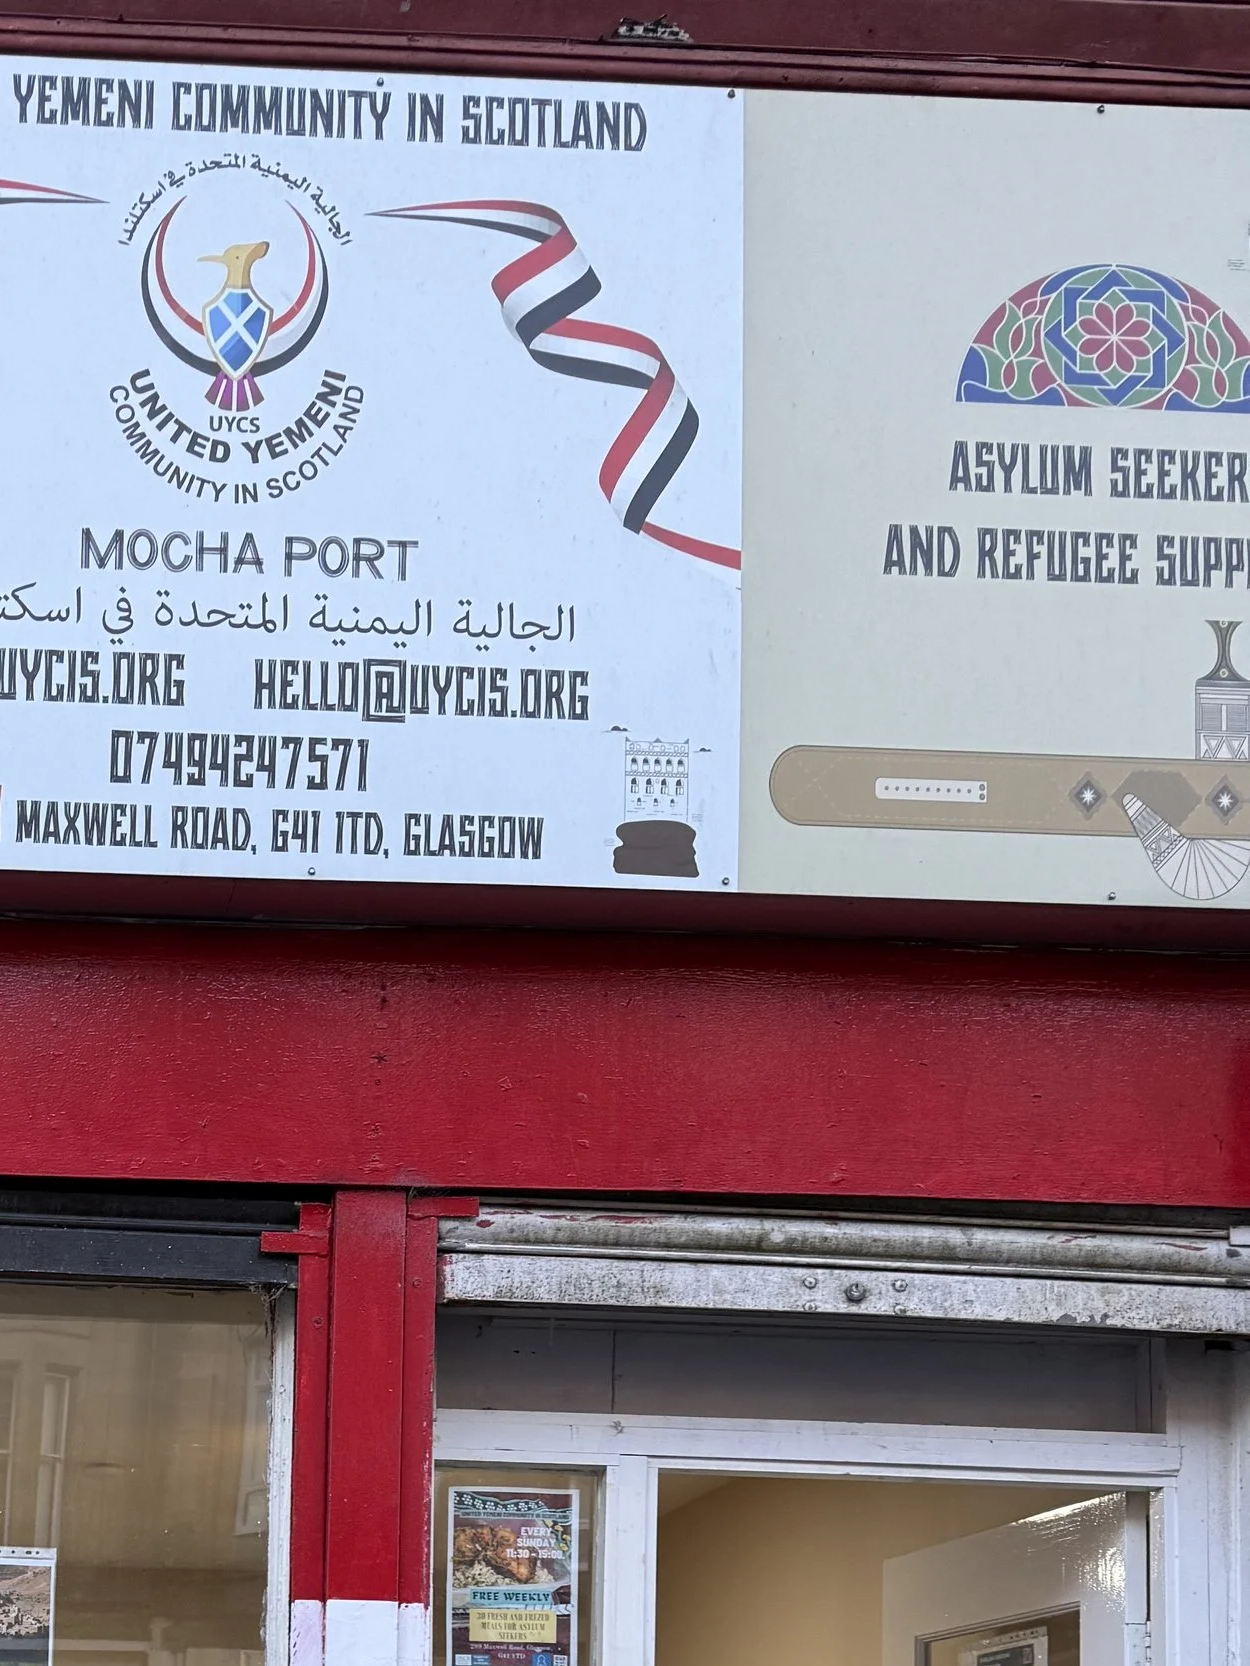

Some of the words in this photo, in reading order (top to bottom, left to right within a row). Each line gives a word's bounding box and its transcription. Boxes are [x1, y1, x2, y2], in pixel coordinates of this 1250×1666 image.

[12, 73, 156, 130] YEMENI
[171, 80, 393, 141] COMMUNITY
[406, 92, 445, 144] IN
[461, 98, 649, 153] SCOTLAND
[163, 169, 187, 188] في
[186, 152, 246, 178] المتحدة
[250, 153, 311, 193] اليمنية
[309, 186, 353, 246] الجالية
[109, 385, 227, 503] COMMUNITY
[233, 482, 259, 504] IN
[265, 384, 365, 499] SCOTLAND
[129, 368, 231, 464] UNITED
[241, 369, 347, 464] YEMENI
[208, 415, 261, 434] UYCS
[948, 439, 1093, 497] ASYLUM
[79, 527, 265, 575] MOCHA
[283, 535, 420, 582] PORT
[882, 523, 962, 578] AND
[976, 527, 1140, 585] REFUGEE
[1155, 533, 1250, 590] SUPP
[100, 585, 136, 644] في
[154, 588, 289, 637] المتحدة
[307, 591, 434, 649] اليمنية
[451, 596, 577, 654] الجالية
[253, 656, 590, 723] HELLO@UYCIS.ORG
[109, 729, 370, 792] 07494247571
[15, 799, 159, 849] MAXWELL
[170, 804, 257, 856] ROAD,
[270, 809, 320, 854] G41
[402, 813, 544, 860] GLASGOW
[516, 1538, 556, 1547] SUNDAY
[520, 1526, 551, 1536] EVERY
[472, 1591, 500, 1600] FREE
[503, 1592, 550, 1602] WEEKLY
[487, 1612, 508, 1620] FRESH
[510, 1613, 523, 1621] AND
[481, 1621, 502, 1630] MEALS
[504, 1622, 517, 1631] FOR
[519, 1623, 546, 1631] ASYLUM
[498, 1631, 528, 1640] SEEKERS
